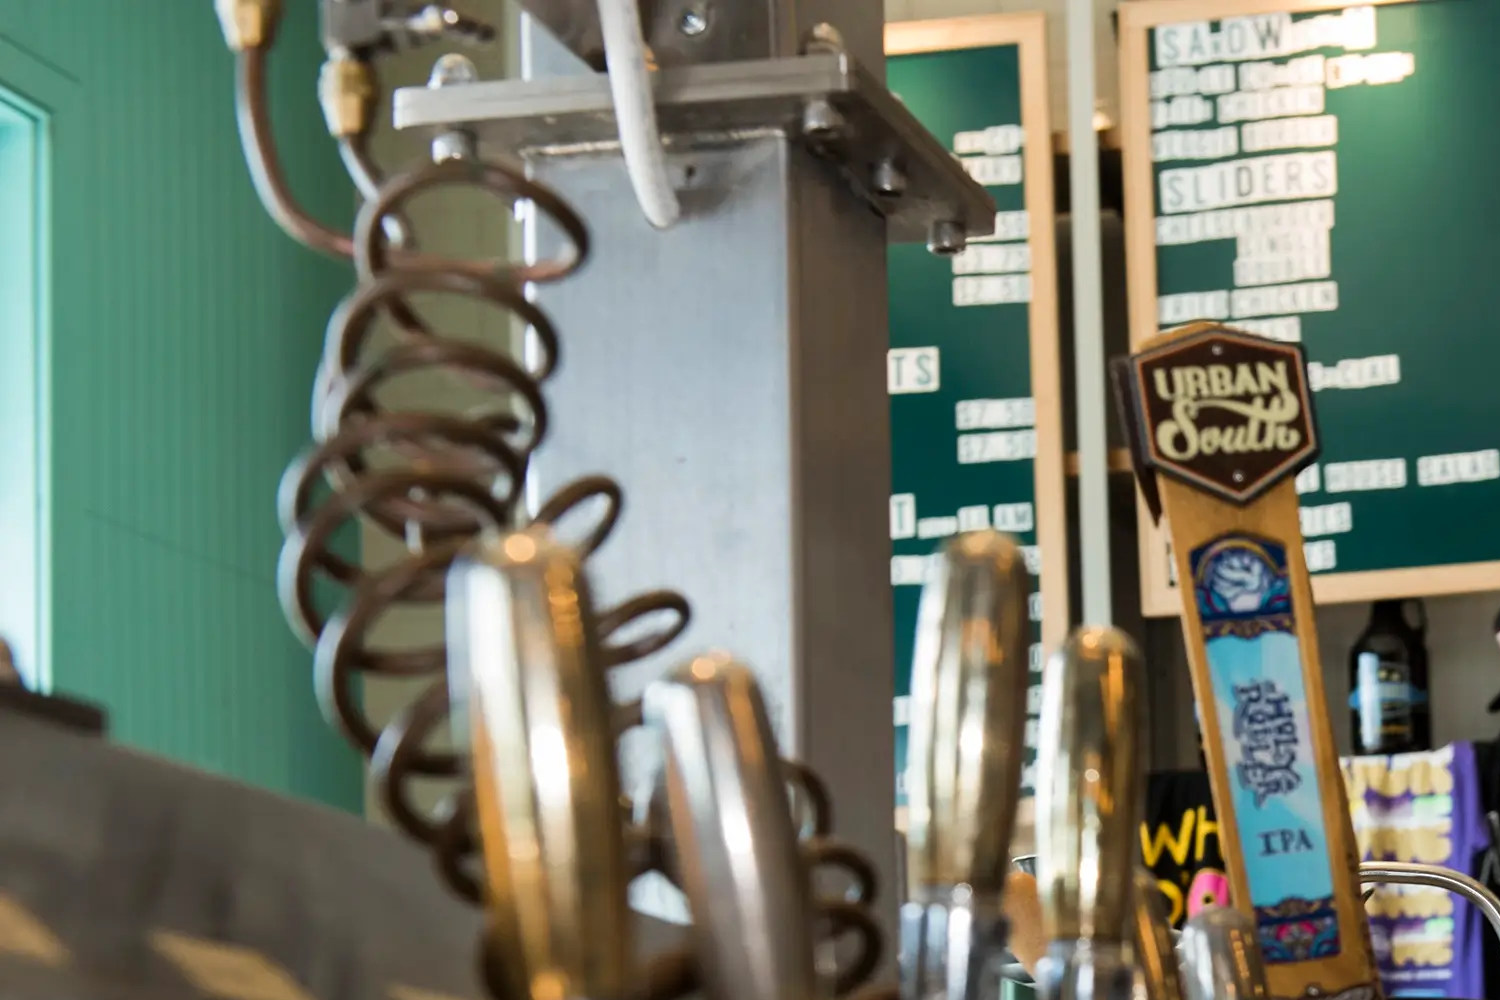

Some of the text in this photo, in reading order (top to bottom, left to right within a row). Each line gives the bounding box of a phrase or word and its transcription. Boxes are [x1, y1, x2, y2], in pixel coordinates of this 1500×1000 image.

[1167, 158, 1329, 207] SLIDERS
[1153, 360, 1291, 400] URBAN
[1156, 388, 1300, 461] South
[1258, 828, 1313, 856] IPA
